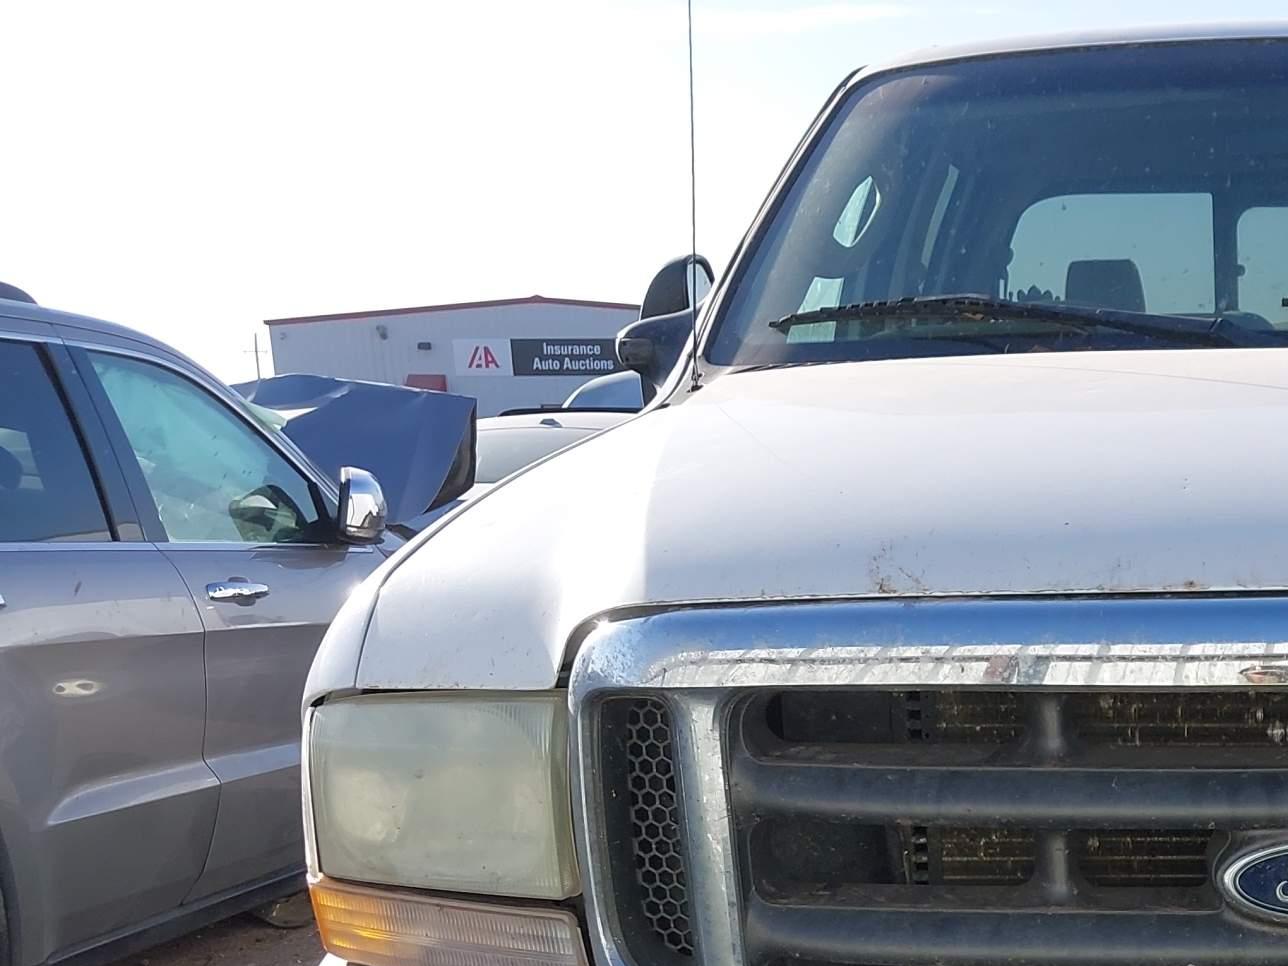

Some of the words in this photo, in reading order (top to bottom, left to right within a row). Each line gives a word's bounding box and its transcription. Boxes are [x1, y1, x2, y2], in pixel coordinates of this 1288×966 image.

[542, 342, 602, 356] Insurance
[532, 357, 561, 371] Auto
[563, 356, 615, 371] Auctions
